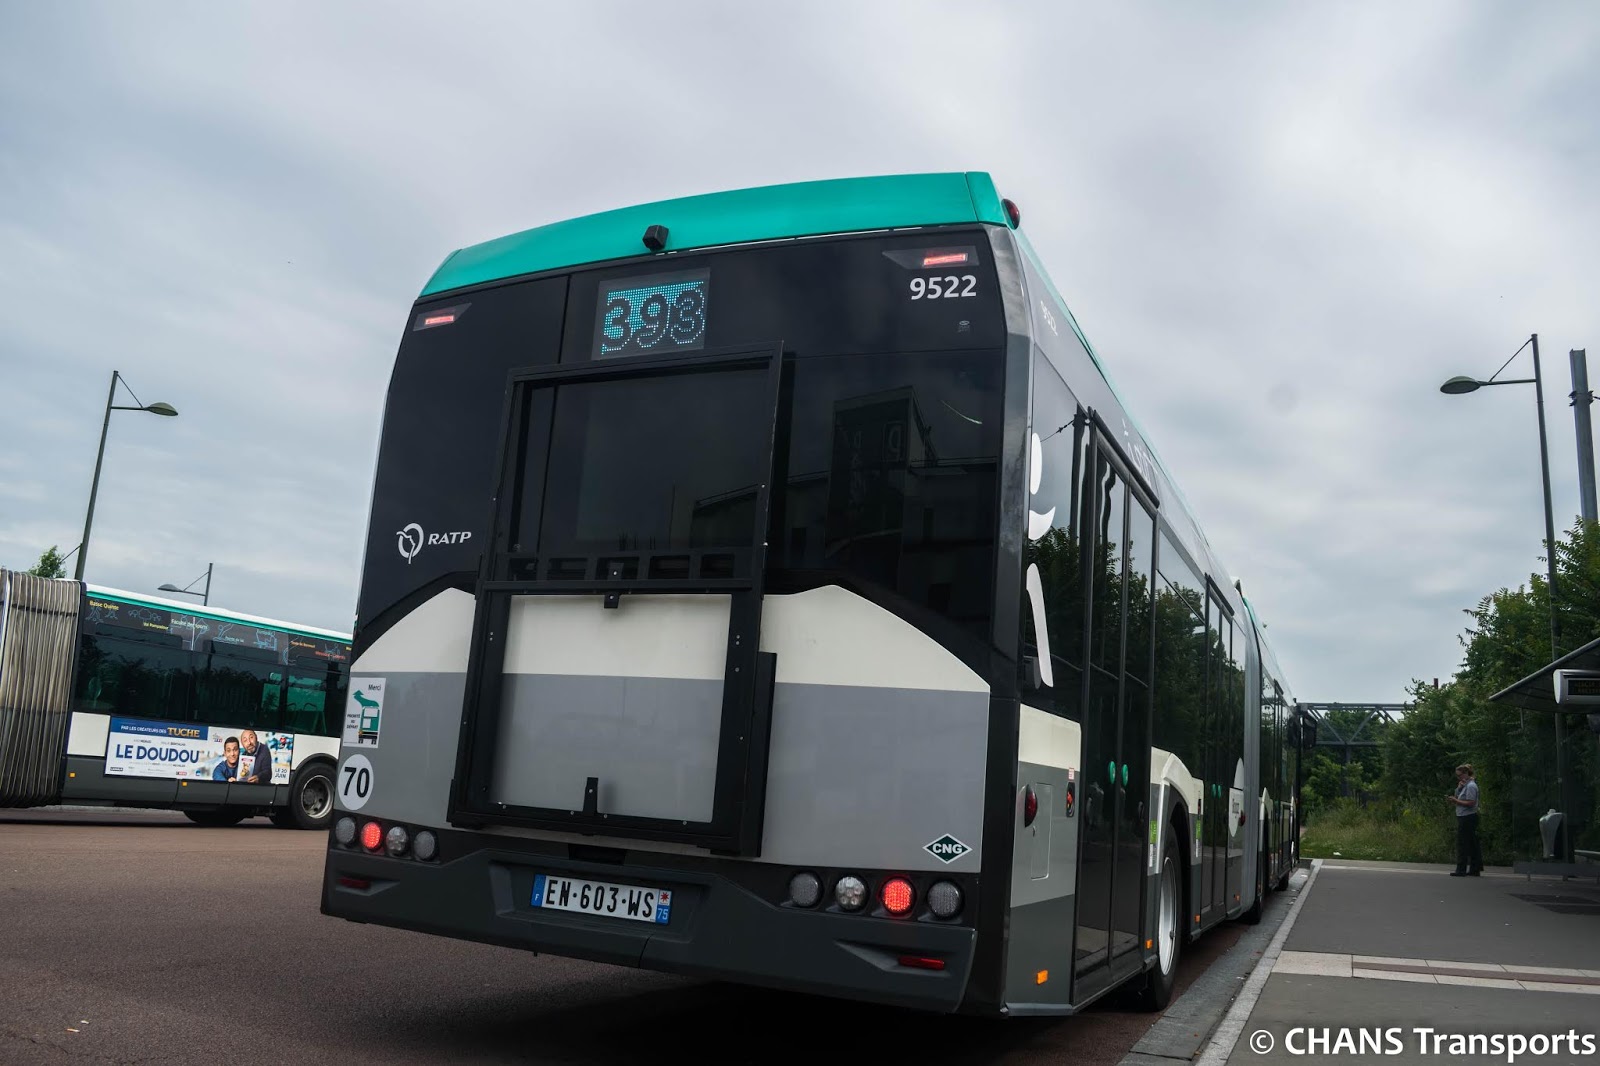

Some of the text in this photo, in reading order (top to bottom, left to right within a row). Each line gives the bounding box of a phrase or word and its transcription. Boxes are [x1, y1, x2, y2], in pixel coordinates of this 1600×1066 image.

[909, 274, 977, 300] 9522
[602, 284, 705, 353] 393
[427, 531, 472, 545] RATP
[368, 683, 382, 691] Merci
[167, 727, 200, 738] TUCHE
[115, 743, 134, 759] LE
[136, 745, 200, 764] DOUDOU
[343, 766, 370, 798] 70
[932, 843, 963, 854] CNG
[657, 908, 669, 920] 75
